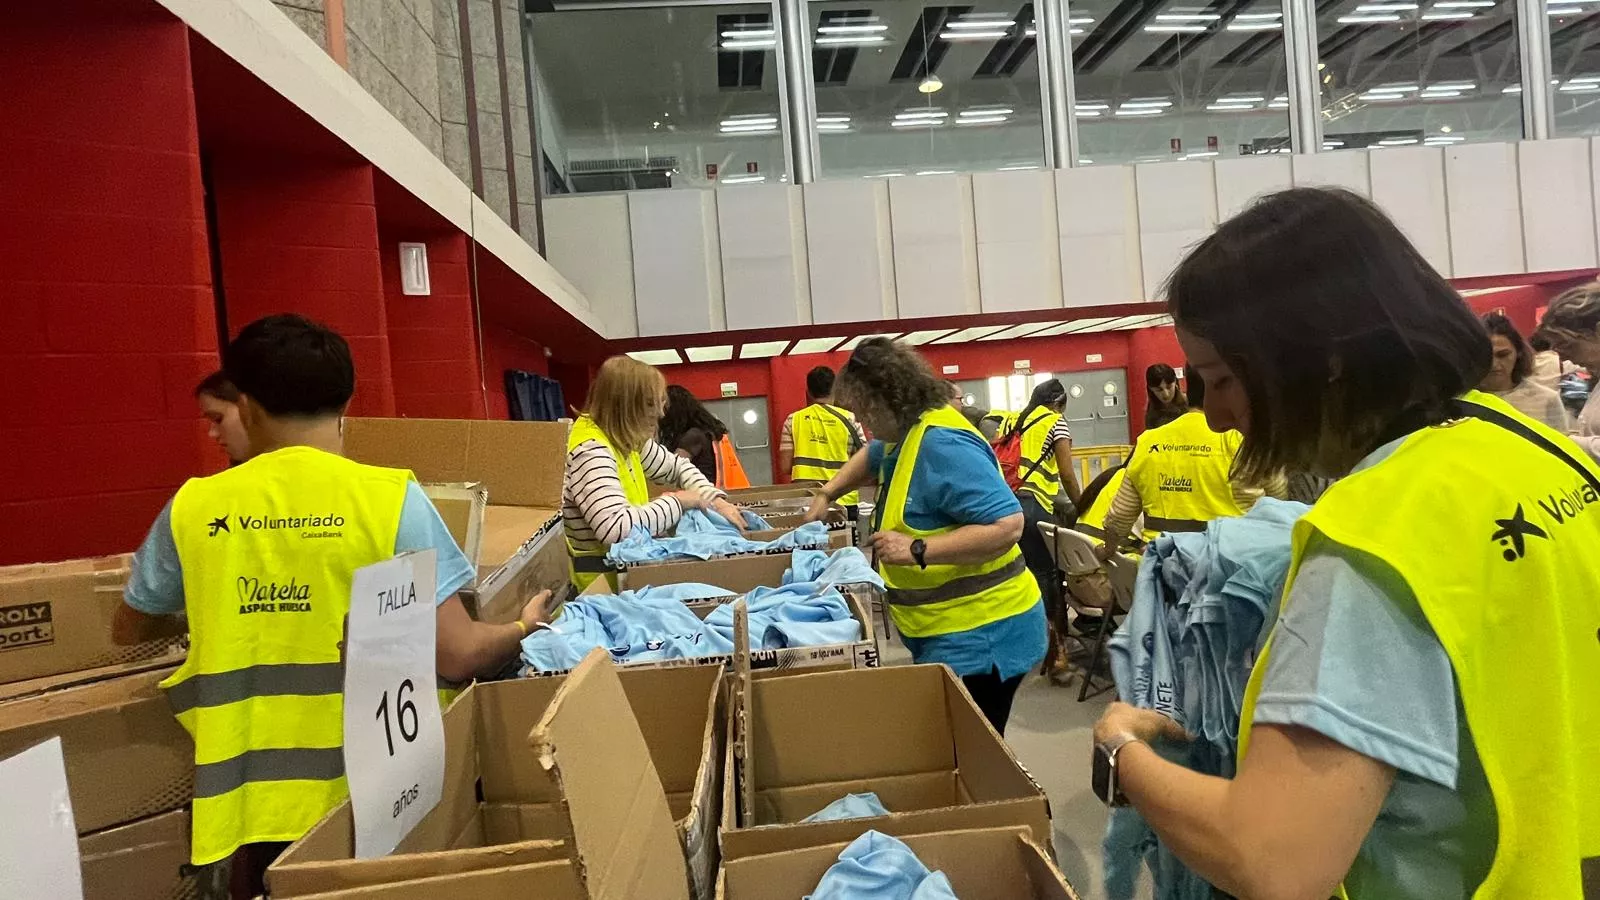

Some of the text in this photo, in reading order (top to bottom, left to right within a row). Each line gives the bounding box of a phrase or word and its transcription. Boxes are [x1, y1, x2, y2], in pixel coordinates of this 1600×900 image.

[1162, 443, 1212, 453] Voluntariado
[239, 513, 345, 530] Voluntariado
[301, 531, 343, 539] CaixaBank
[237, 576, 313, 602] Marcha
[377, 581, 417, 617] TALLA
[239, 602, 312, 615] ASPACE HUESCA
[375, 678, 419, 757] 16
[392, 783, 419, 819] años
